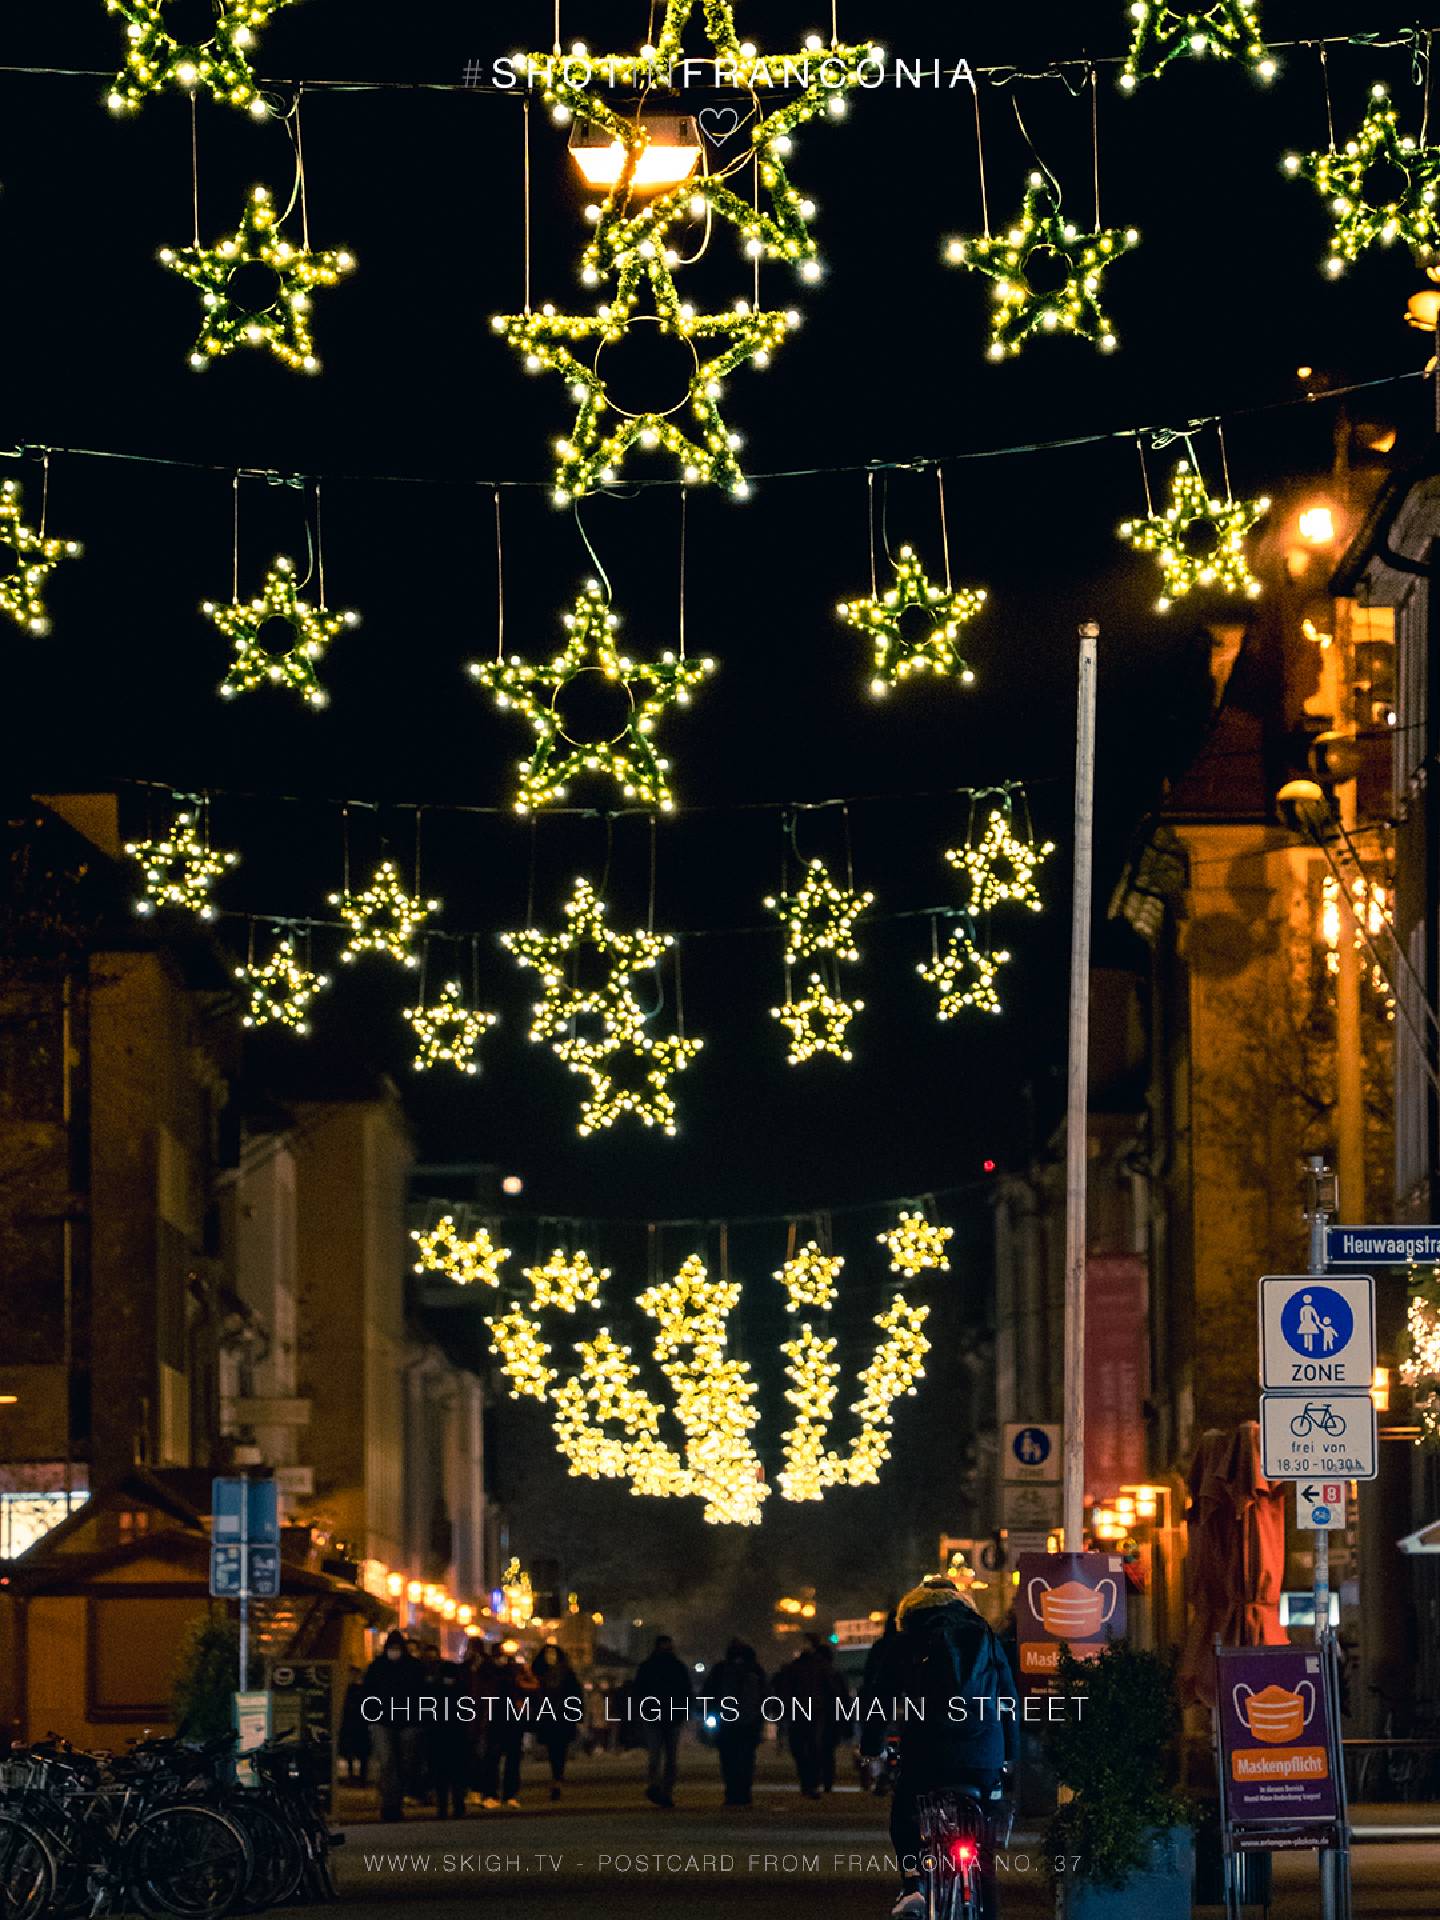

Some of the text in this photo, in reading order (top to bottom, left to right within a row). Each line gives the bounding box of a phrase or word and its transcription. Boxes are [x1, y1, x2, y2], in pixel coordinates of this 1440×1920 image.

[1291, 1363, 1346, 1381] ZONE
[1291, 1440, 1346, 1453] frei von
[1237, 1755, 1323, 1777] Maskenpflicht
